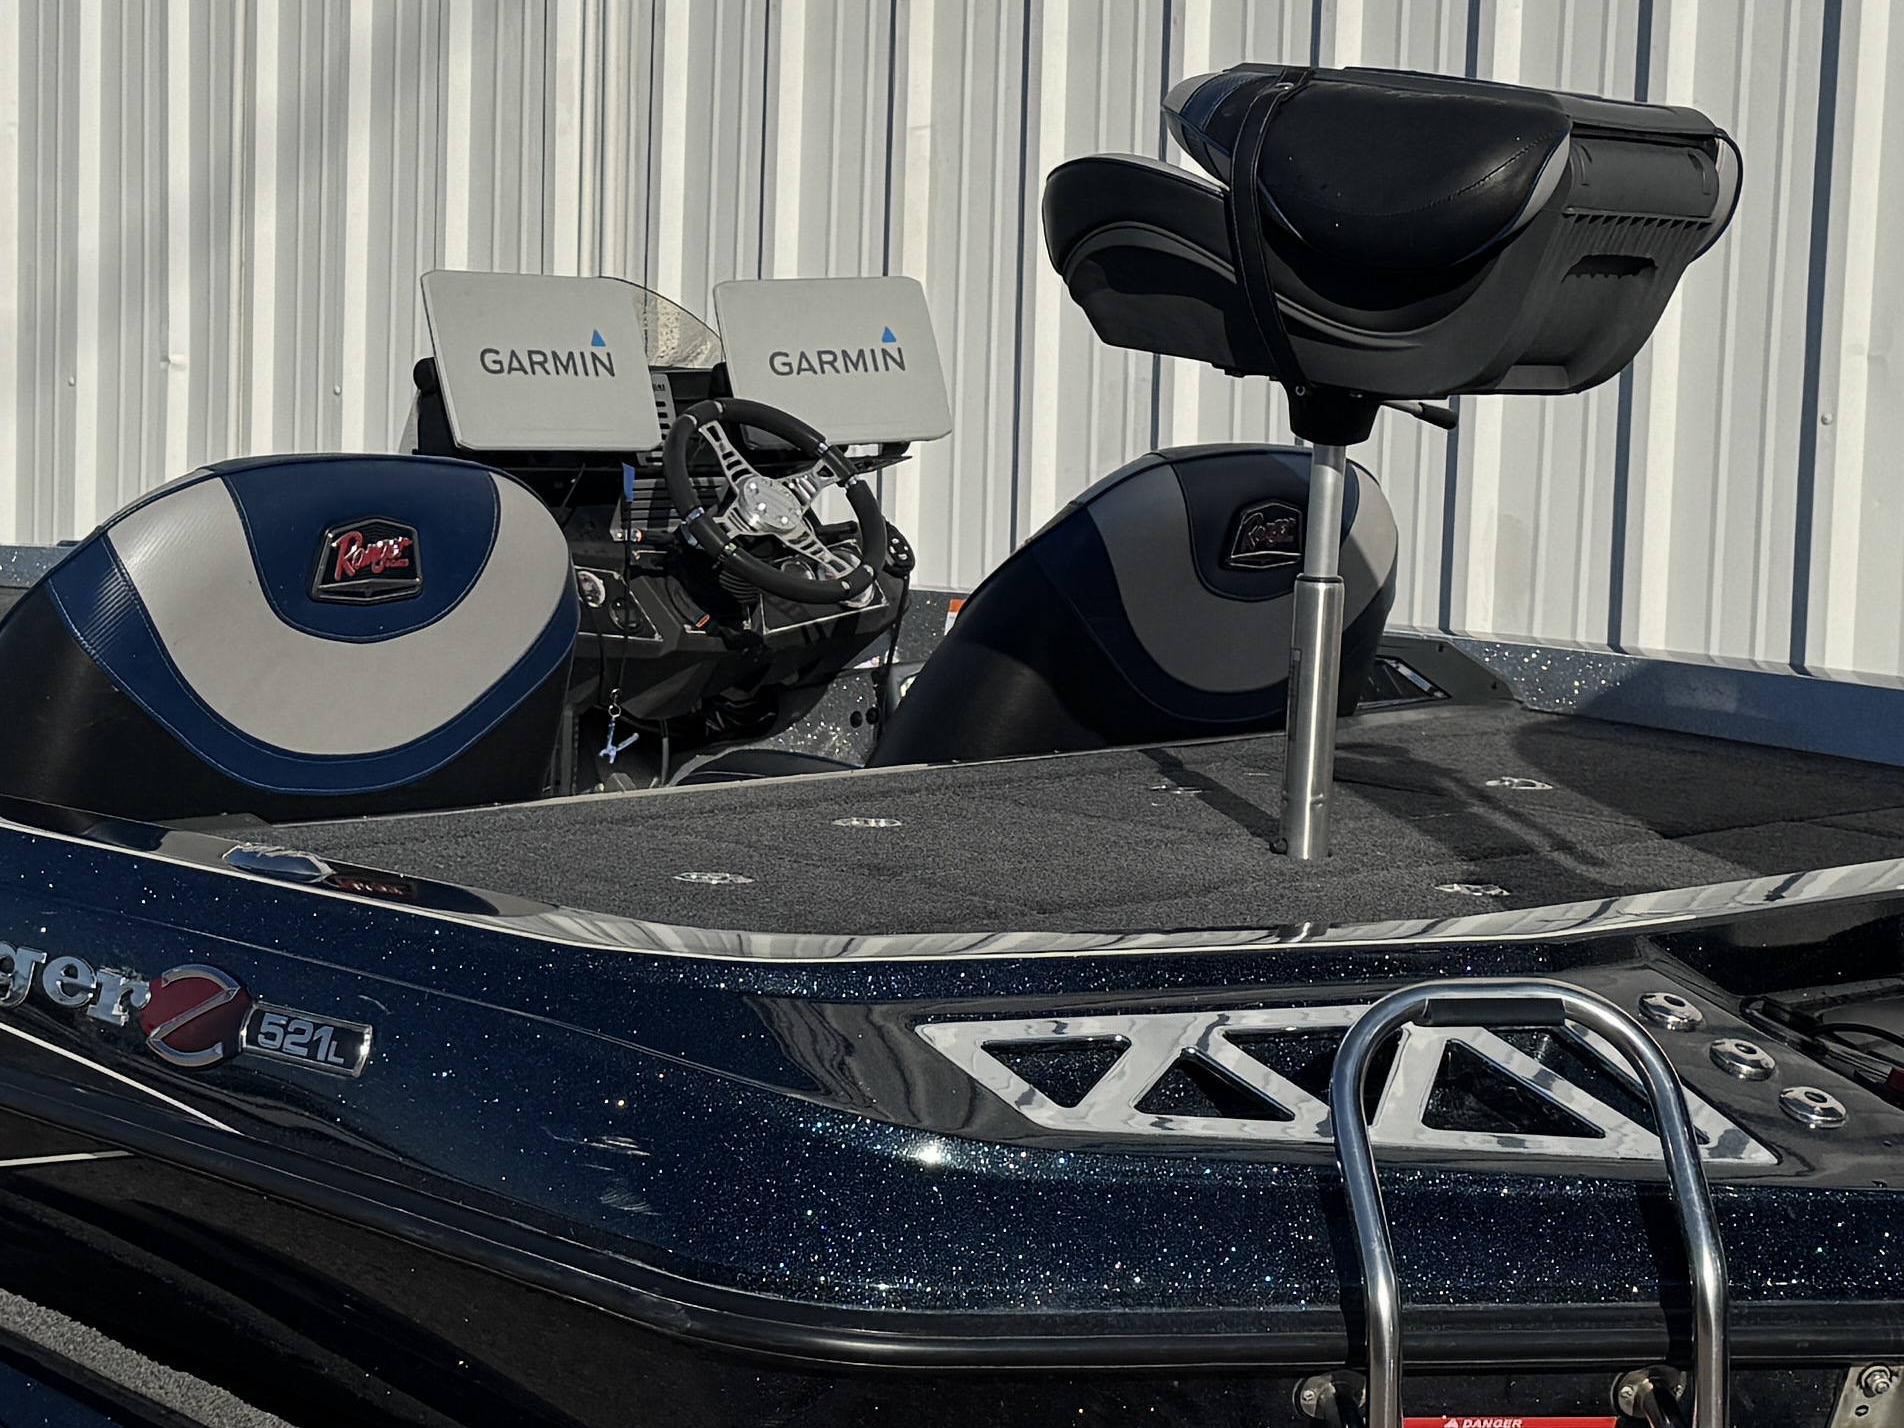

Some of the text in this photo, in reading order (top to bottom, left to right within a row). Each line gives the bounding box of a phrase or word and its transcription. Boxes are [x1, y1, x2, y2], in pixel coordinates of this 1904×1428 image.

[480, 347, 616, 377] GARMIN
[768, 346, 906, 377] GARMIN
[257, 1013, 345, 1066] 521L
[1462, 1418, 1523, 1428] DANGER
